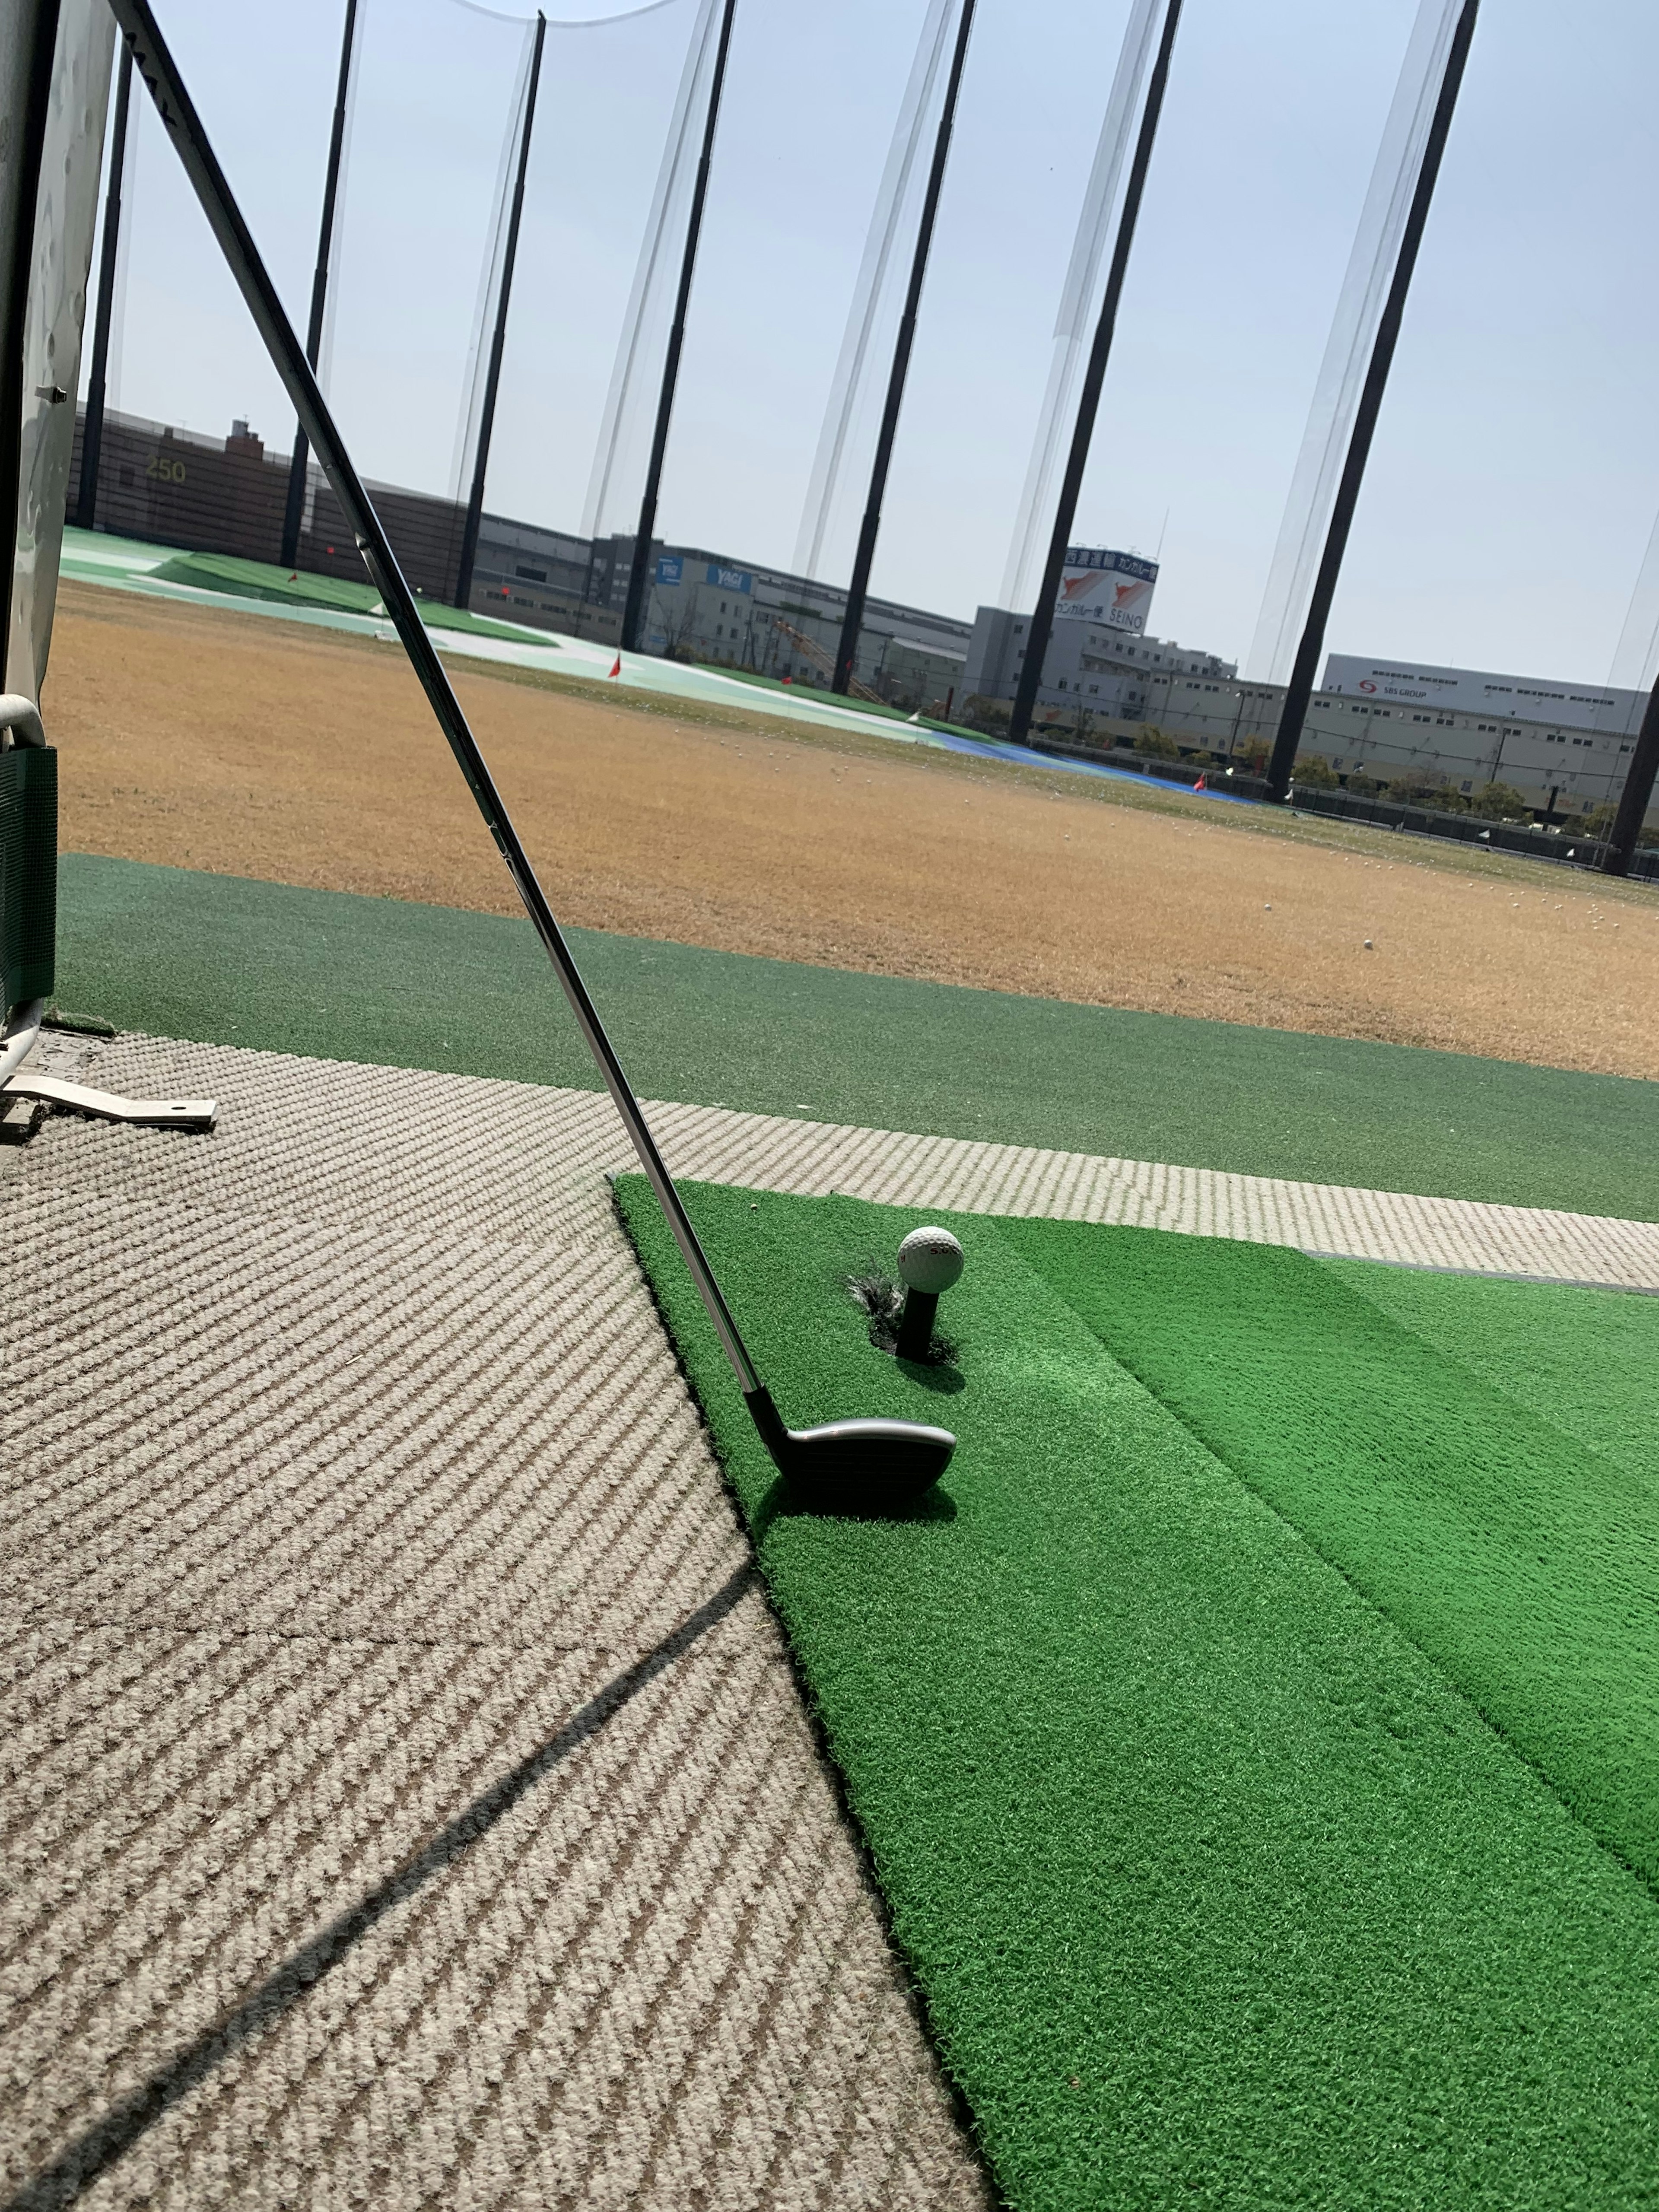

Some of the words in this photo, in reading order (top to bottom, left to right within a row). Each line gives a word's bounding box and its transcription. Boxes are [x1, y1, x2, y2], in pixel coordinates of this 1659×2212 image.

[146, 454, 185, 482] 250
[718, 569, 743, 588] YAGI
[1110, 608, 1142, 628] SEINO
[1384, 686, 1398, 695] SBS
[1399, 689, 1427, 698] GROUP
